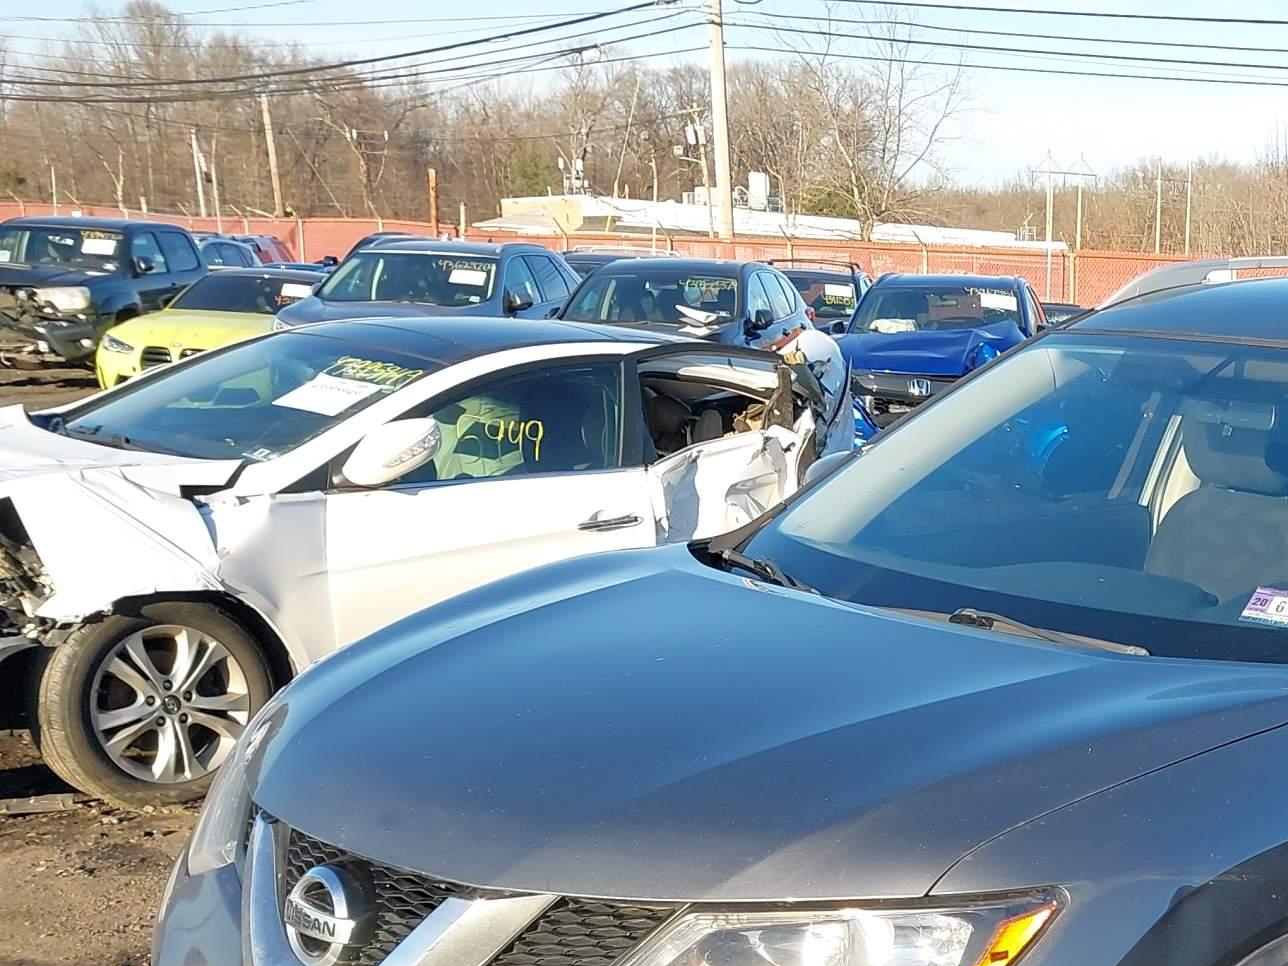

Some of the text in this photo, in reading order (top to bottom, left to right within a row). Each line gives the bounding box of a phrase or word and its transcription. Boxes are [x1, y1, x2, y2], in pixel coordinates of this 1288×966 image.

[456, 413, 544, 464] 5949
[1251, 597, 1269, 608] 20
[1275, 600, 1288, 614] 6
[285, 898, 337, 938] NISSAN
